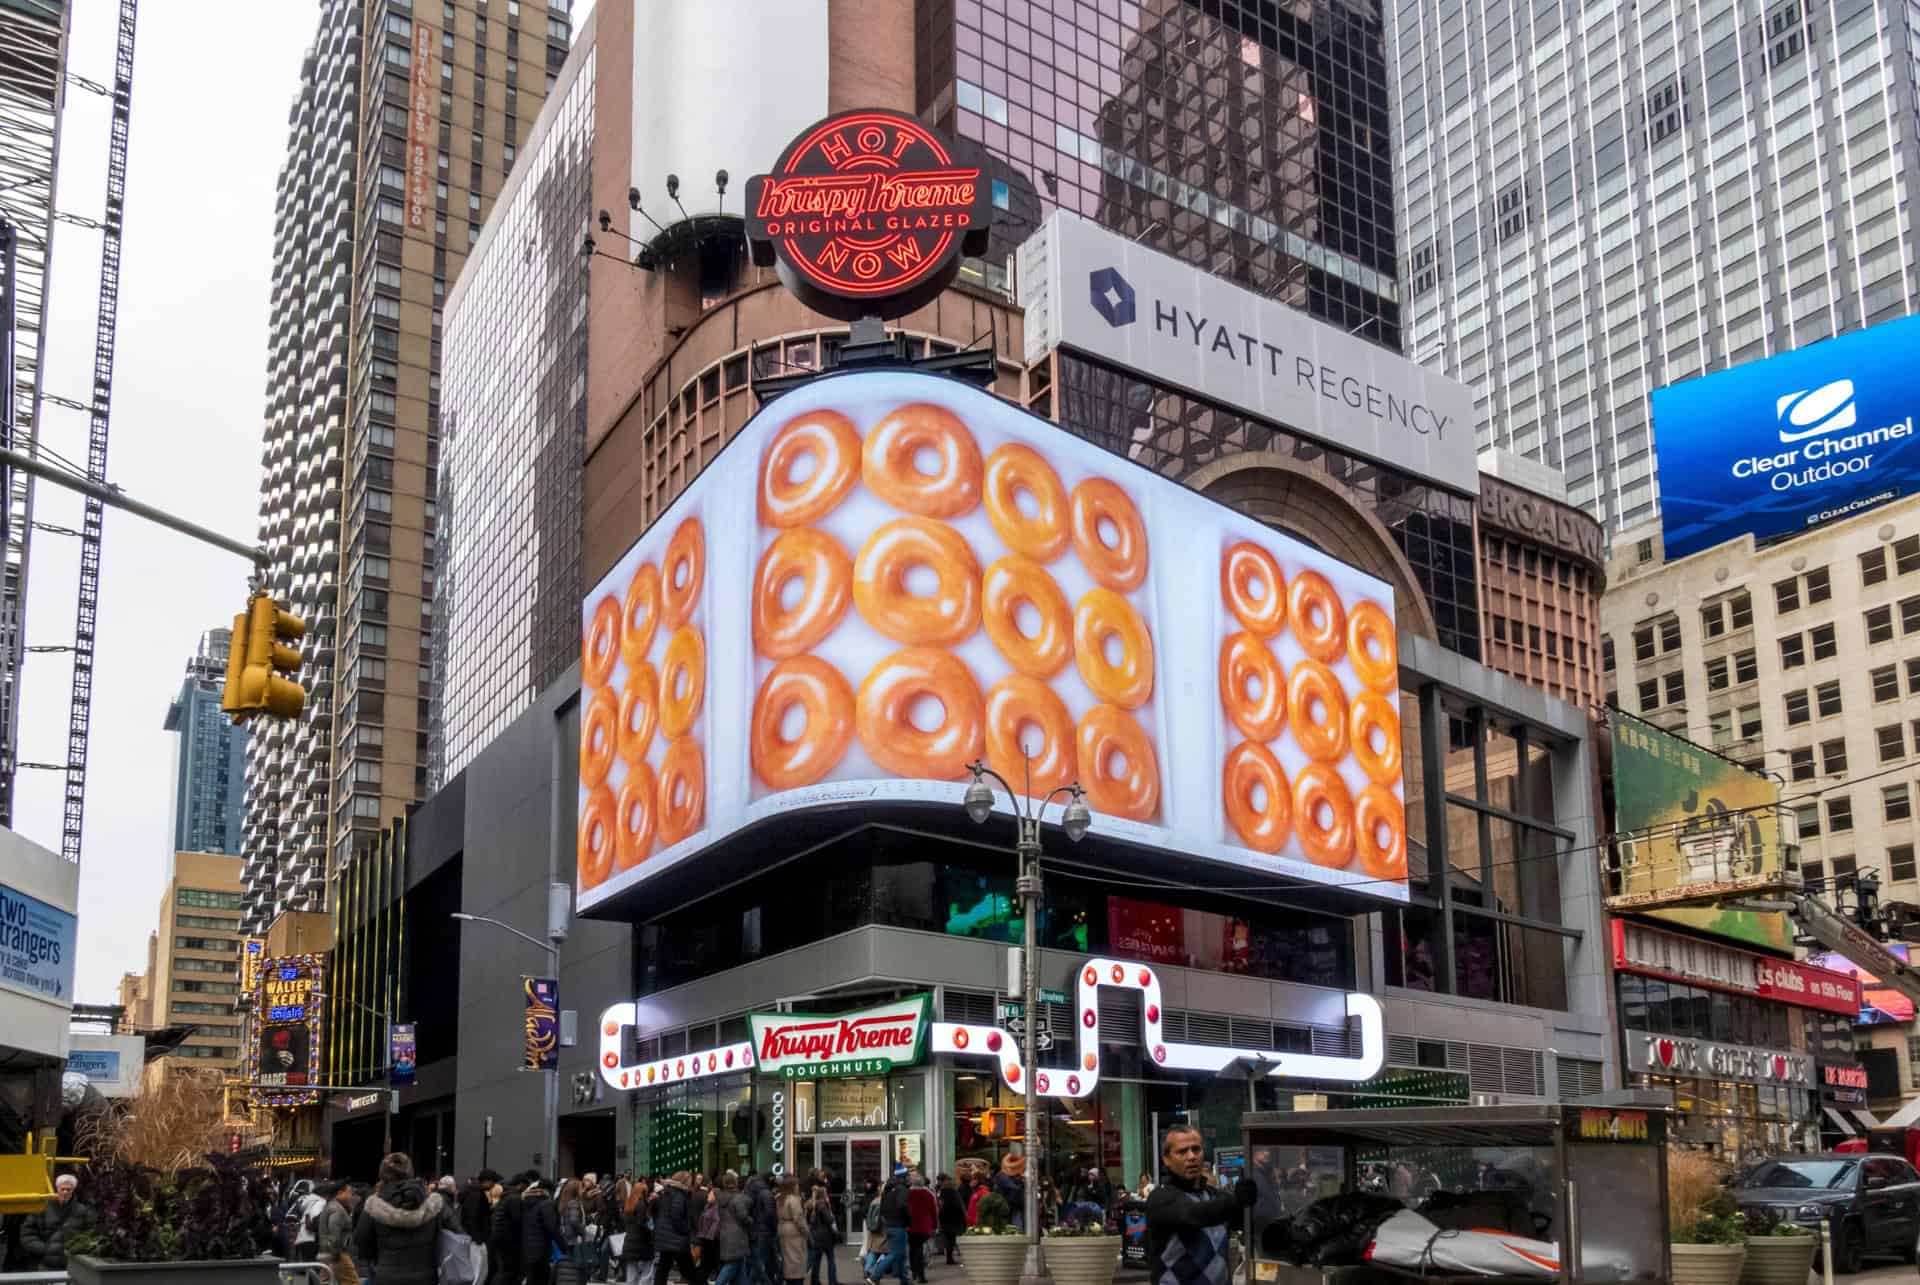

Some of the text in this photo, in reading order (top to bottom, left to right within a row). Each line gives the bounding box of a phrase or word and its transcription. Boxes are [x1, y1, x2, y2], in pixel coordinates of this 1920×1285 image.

[820, 126, 916, 165] HOT
[757, 168, 980, 219] Krispy Kreme
[767, 213, 970, 235] ORIGINAL GLAZED
[816, 236, 922, 280] NOW
[1154, 299, 1448, 441] HYATT REGENCY
[1732, 416, 1913, 478] Clear Channel
[1771, 454, 1873, 491] Outdoor
[267, 980, 312, 994] WALTER
[1775, 967, 1805, 993] clubs
[272, 993, 304, 1006] KERR
[760, 1013, 917, 1060] Krispy Kreme
[786, 1060, 883, 1077] DOUGHNUTS
[1707, 1047, 1759, 1079] GIFTS
